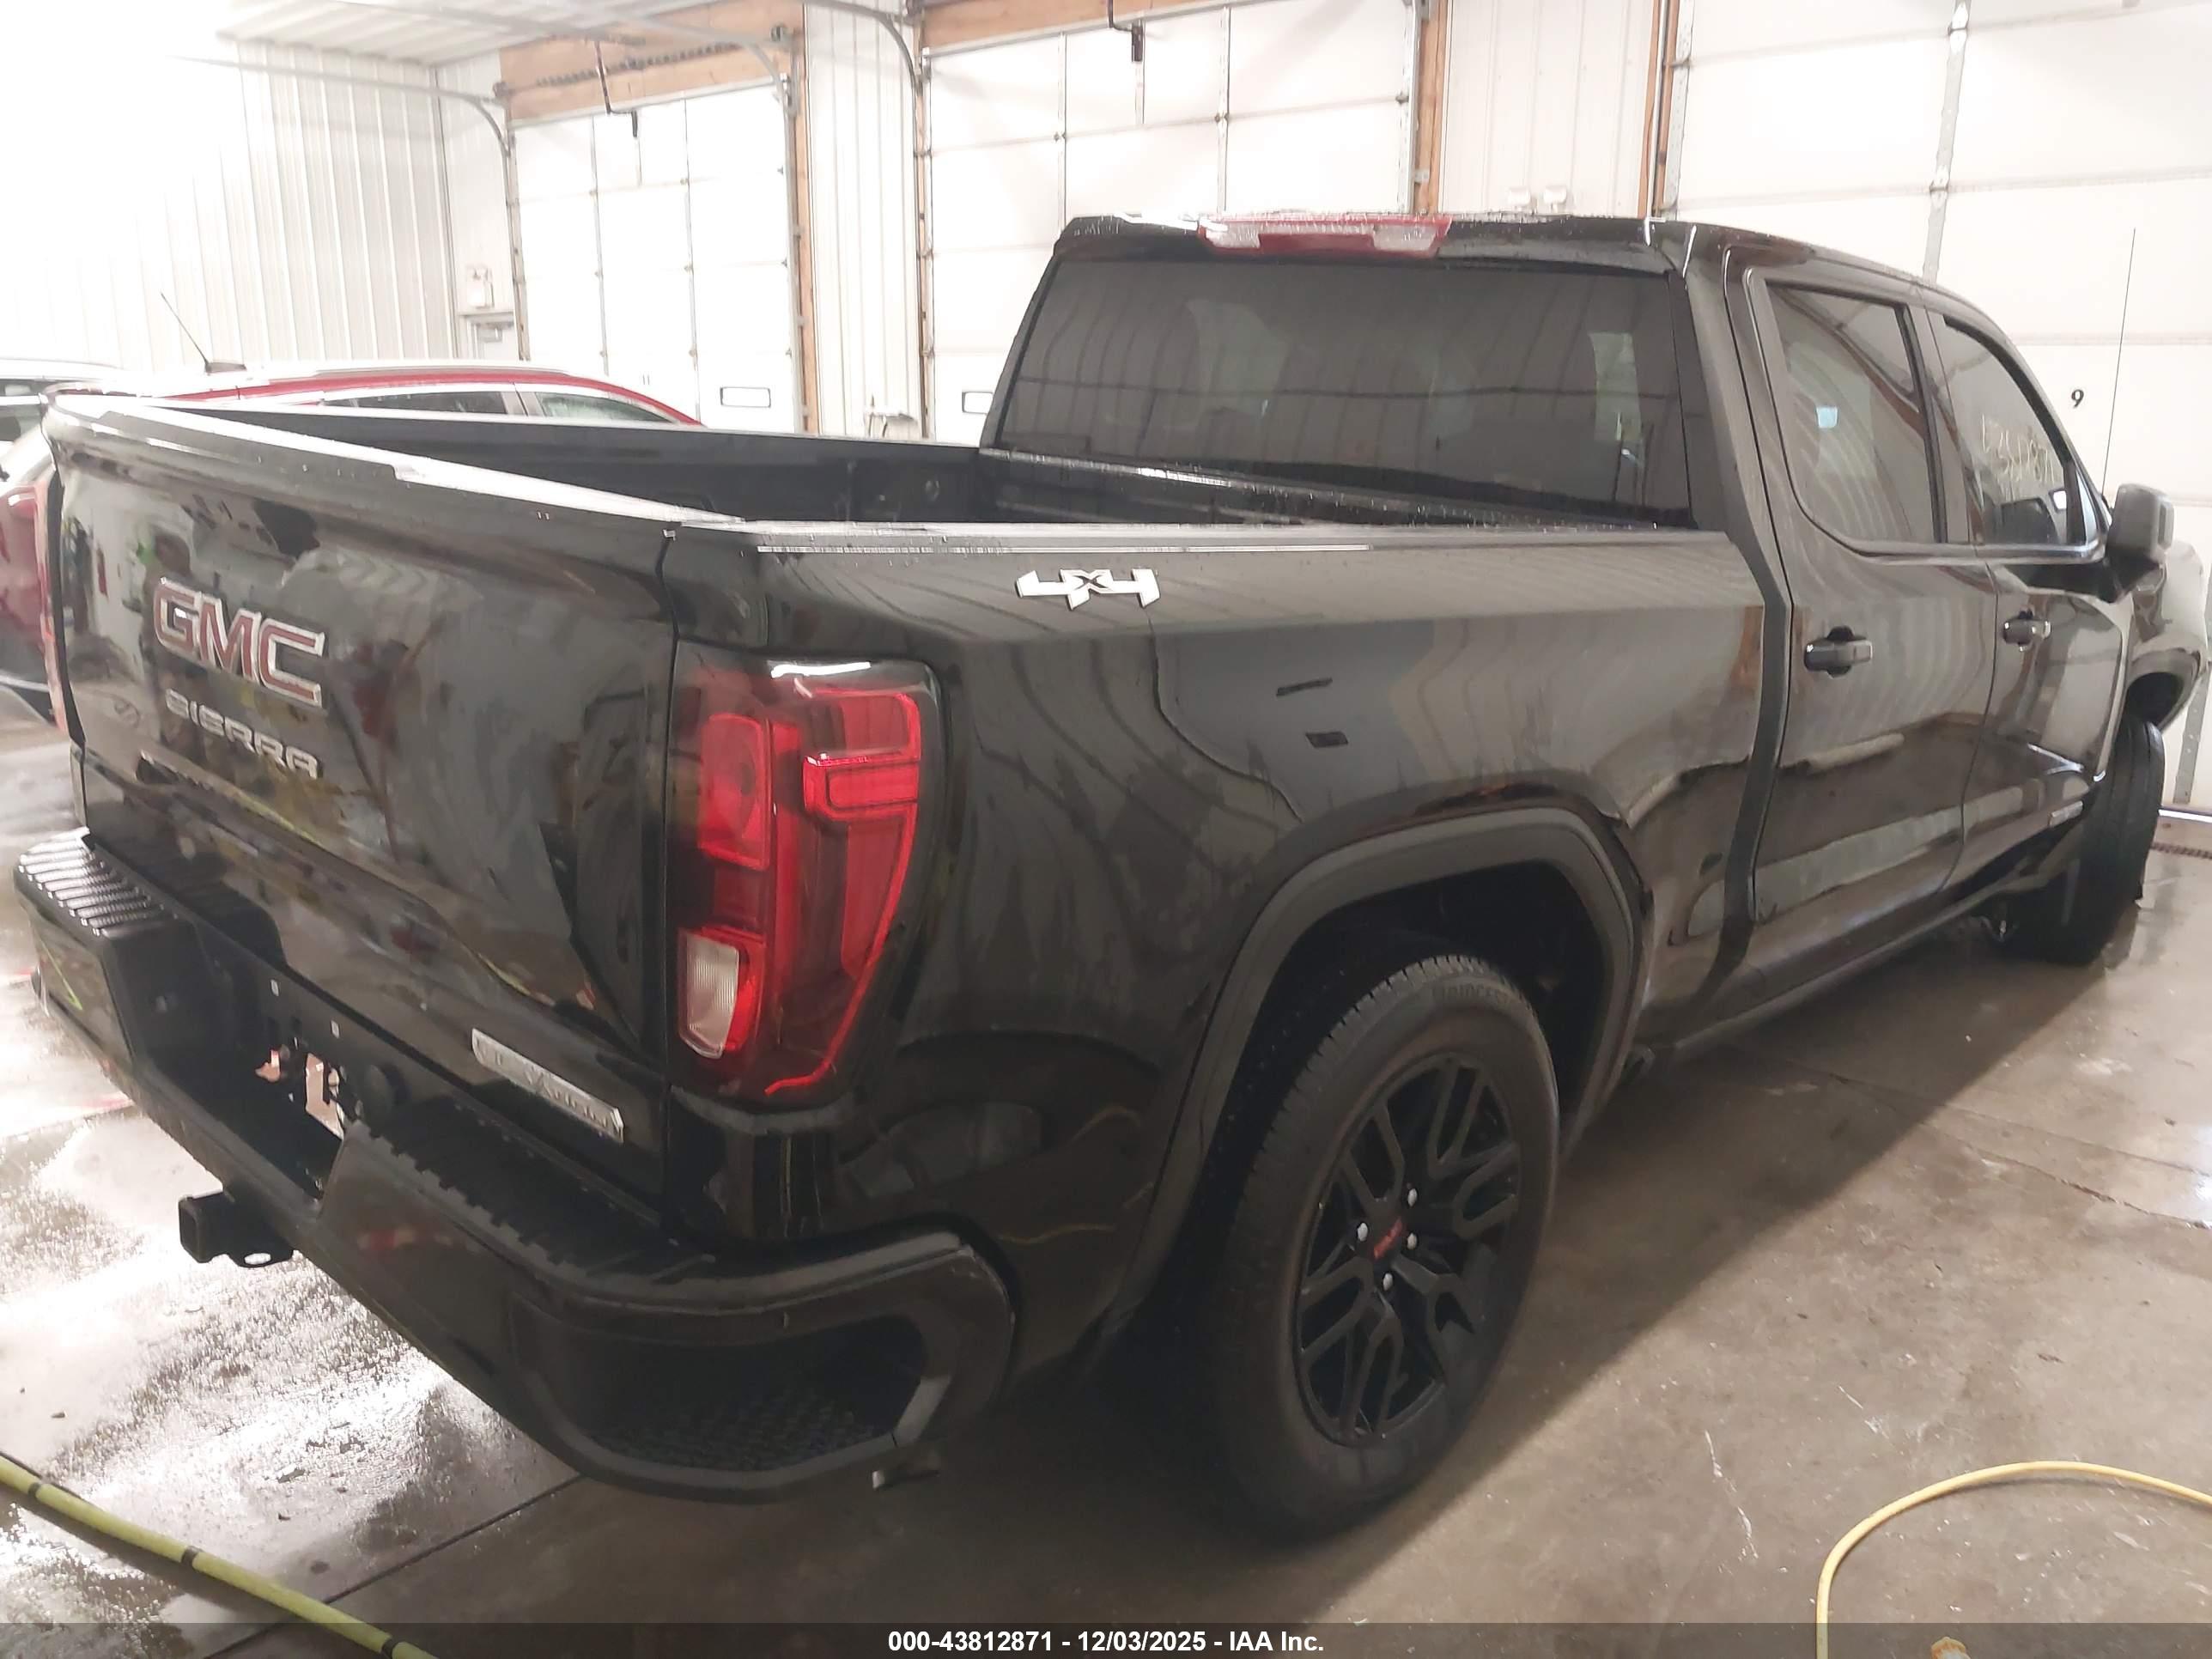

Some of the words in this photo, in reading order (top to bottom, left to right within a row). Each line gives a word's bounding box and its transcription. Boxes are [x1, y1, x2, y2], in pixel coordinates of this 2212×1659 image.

[2070, 388, 2085, 409] 9
[153, 576, 325, 708] GMC
[164, 688, 319, 780] SIERRA
